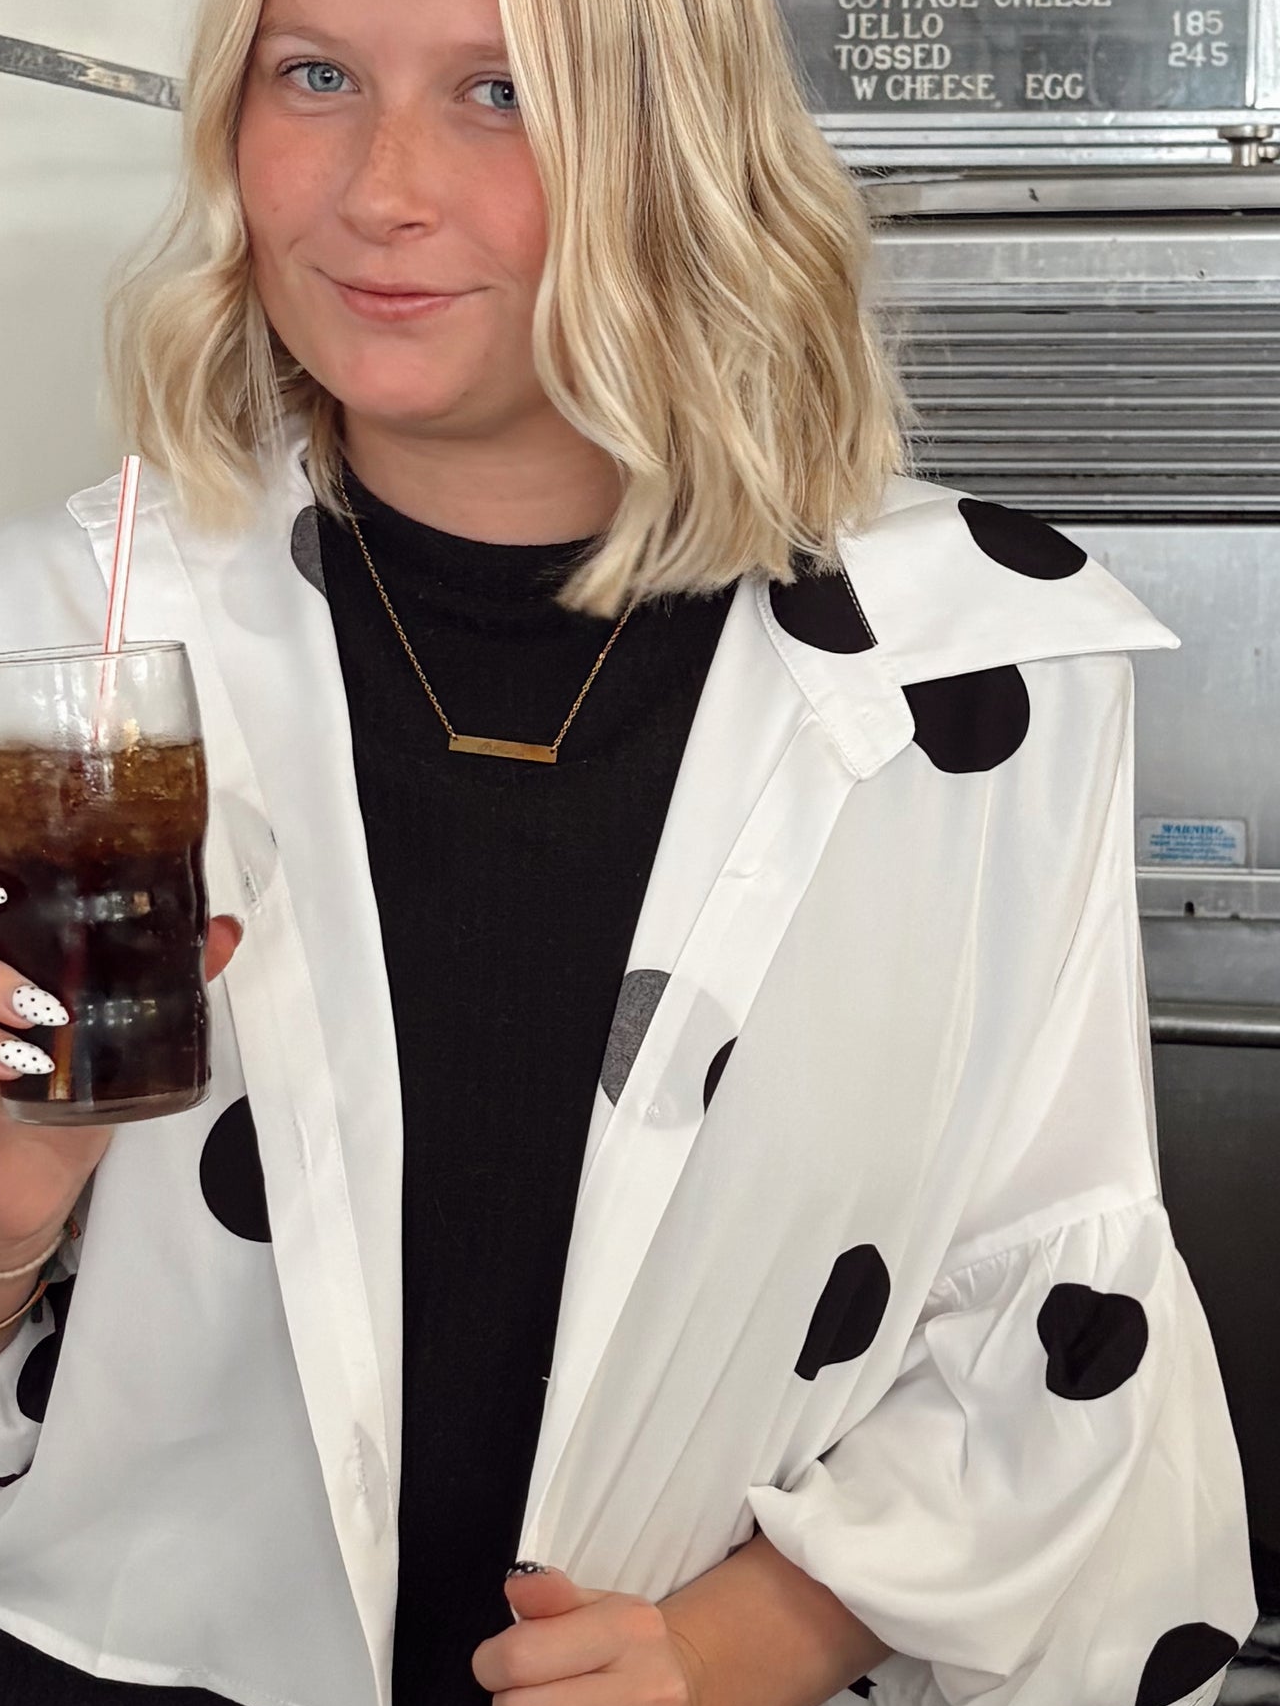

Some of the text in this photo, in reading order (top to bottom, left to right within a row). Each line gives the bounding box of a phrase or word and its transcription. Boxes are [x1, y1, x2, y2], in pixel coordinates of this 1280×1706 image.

[838, 11, 1222, 42] JELLO 185
[834, 42, 1230, 72] TOSSED 245
[879, 73, 996, 103] CHEESE
[1025, 74, 1085, 101] EGG
